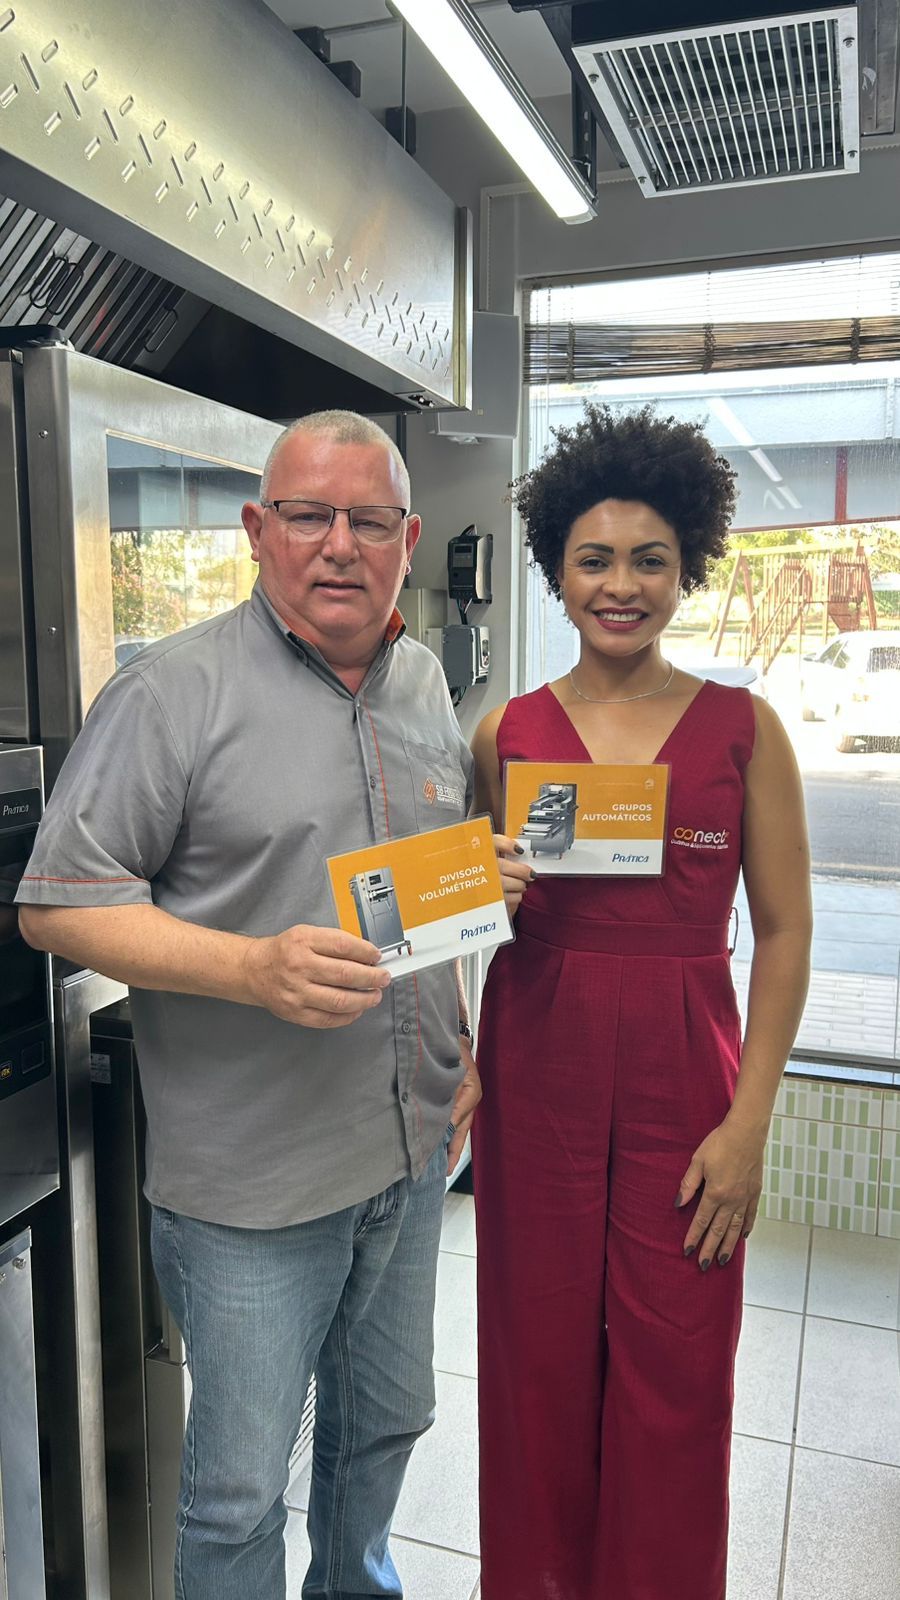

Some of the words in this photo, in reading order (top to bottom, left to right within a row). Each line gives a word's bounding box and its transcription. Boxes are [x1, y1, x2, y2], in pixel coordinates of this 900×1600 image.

[612, 803, 652, 811] GRUPOS
[582, 812, 652, 821] AUTOMÁTICOS
[439, 864, 486, 884] DIVISORA
[419, 876, 488, 902] VOLUMÉTRICA
